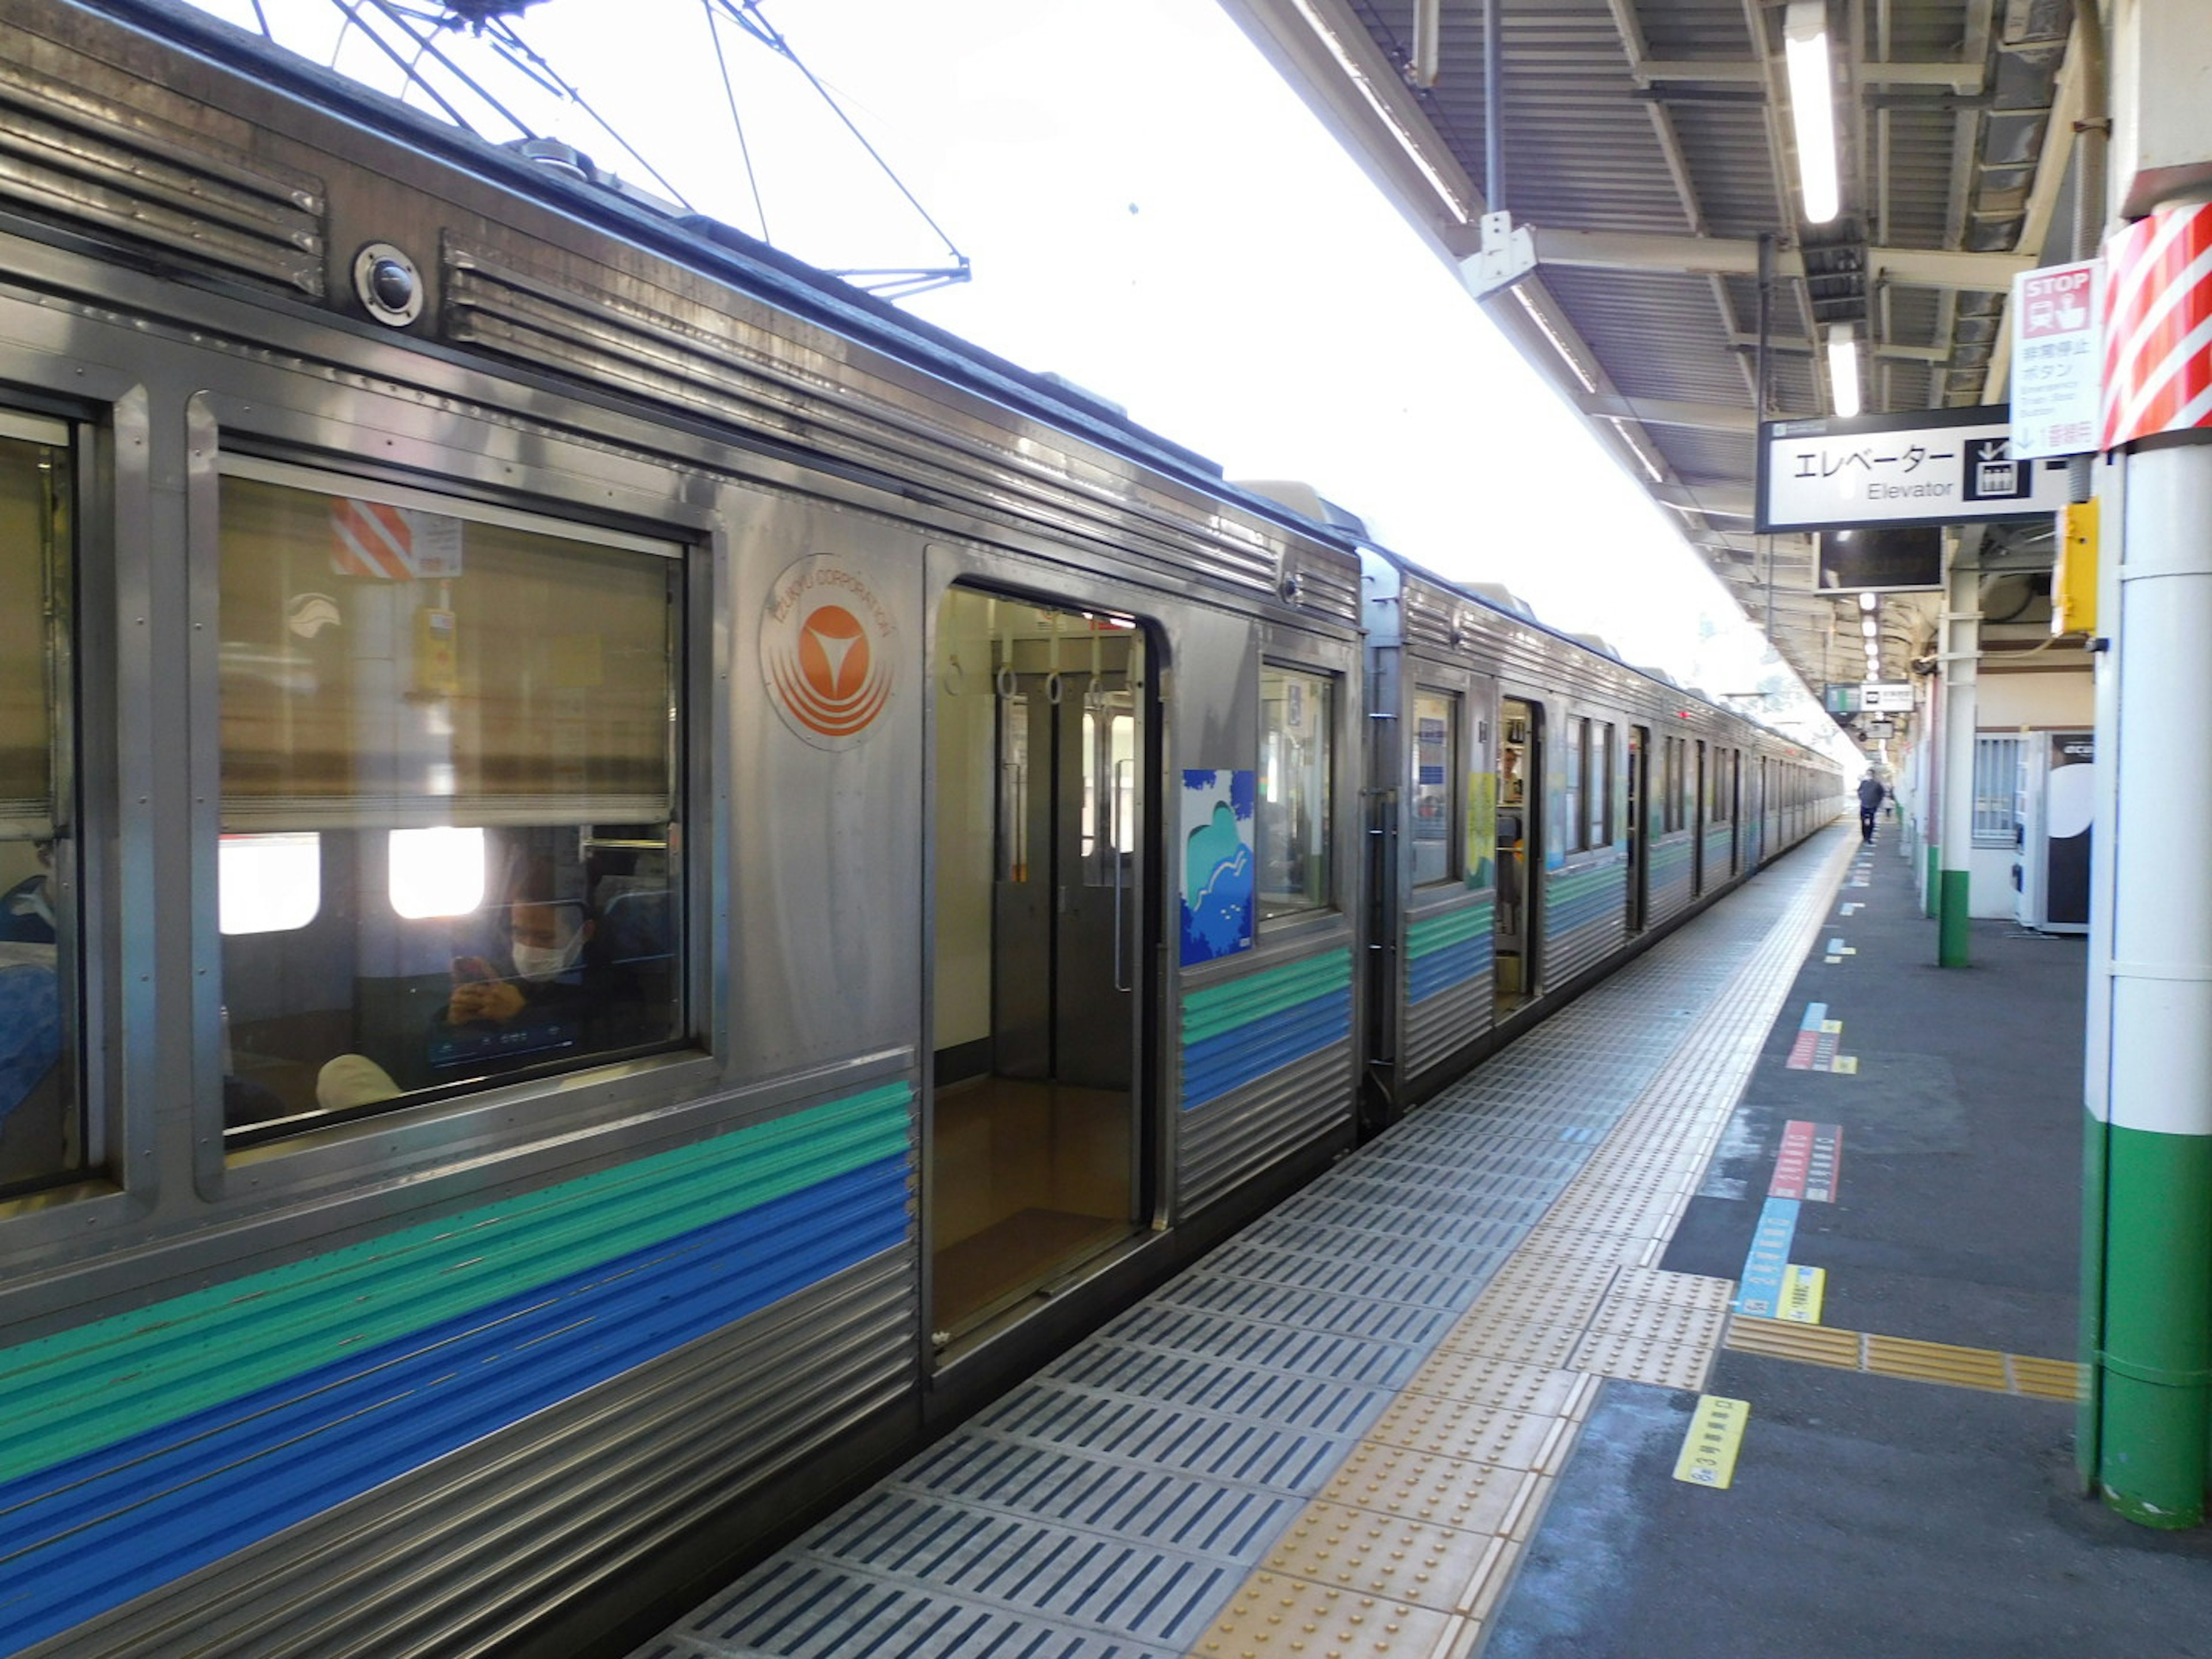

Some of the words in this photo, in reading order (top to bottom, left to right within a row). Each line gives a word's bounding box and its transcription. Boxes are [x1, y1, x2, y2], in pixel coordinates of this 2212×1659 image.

[2026, 272, 2089, 297] STOP
[1794, 444, 1955, 478] エレベーター
[1868, 482, 1953, 500] Elevator
